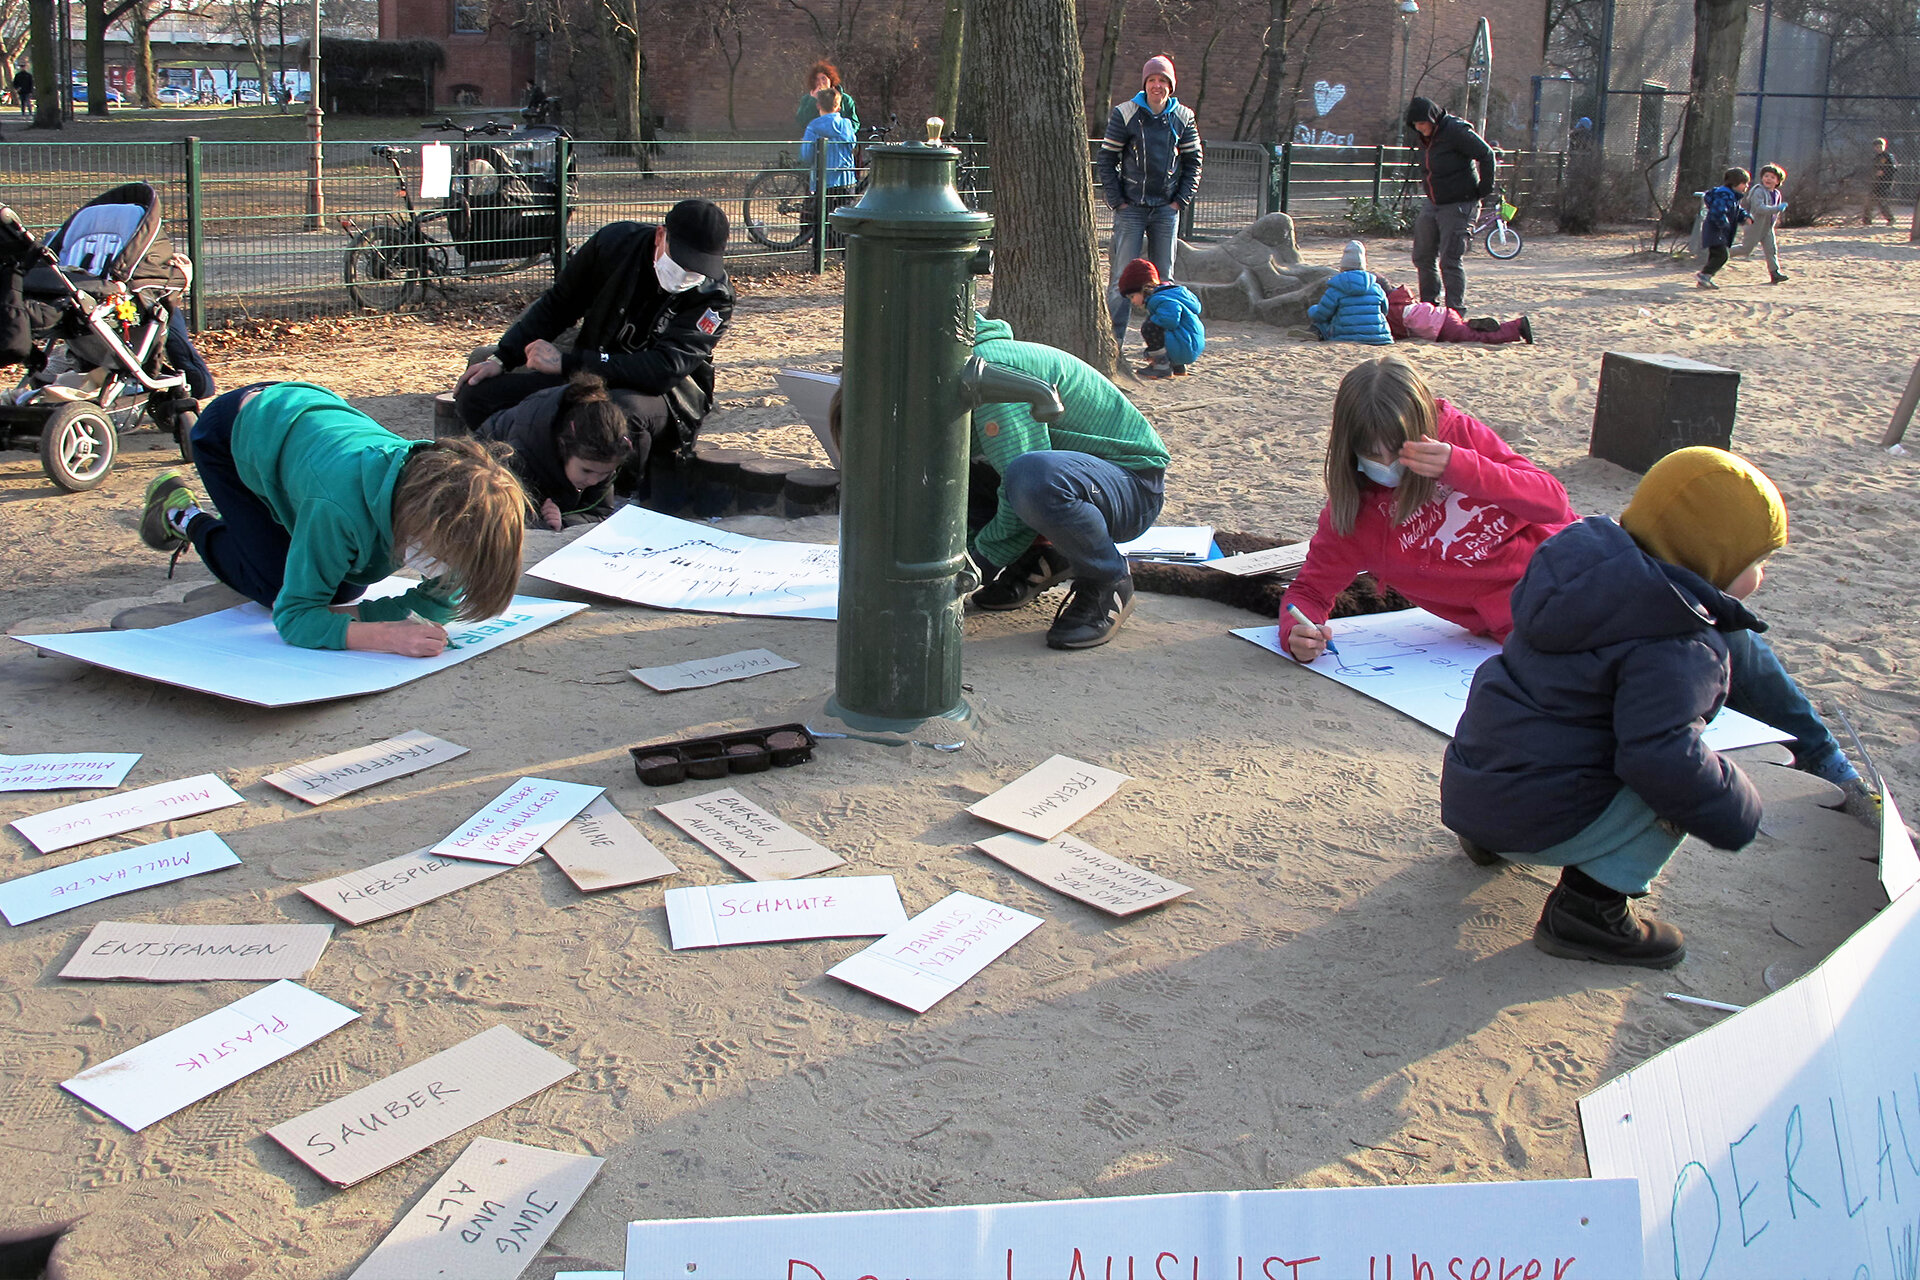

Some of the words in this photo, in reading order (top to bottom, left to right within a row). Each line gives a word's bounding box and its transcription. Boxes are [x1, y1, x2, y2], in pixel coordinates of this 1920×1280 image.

[1465, 515, 1509, 550] Bester
[301, 744, 435, 791] TREFFPUNKT
[48, 818, 91, 834] WEG
[101, 805, 144, 820] SOLL
[450, 816, 495, 848] KLEINE
[493, 785, 537, 815] KINDER
[480, 788, 560, 850] VERSCHLUCKEN
[695, 801, 772, 848] LOSWERDEN
[716, 797, 782, 834] ENERGIE
[684, 817, 757, 859] AUSTOBEN
[337, 858, 461, 904] KIEZSPIEL
[1092, 890, 1133, 906] AUS
[717, 895, 838, 917] SCHMUTZ
[91, 940, 288, 956] ENTSPANNEN
[175, 1014, 290, 1072] PLASTIK
[306, 1081, 462, 1157] SAUBER
[426, 1179, 477, 1232] ALT
[460, 1199, 506, 1244] UND
[495, 1189, 559, 1254] JUNG
